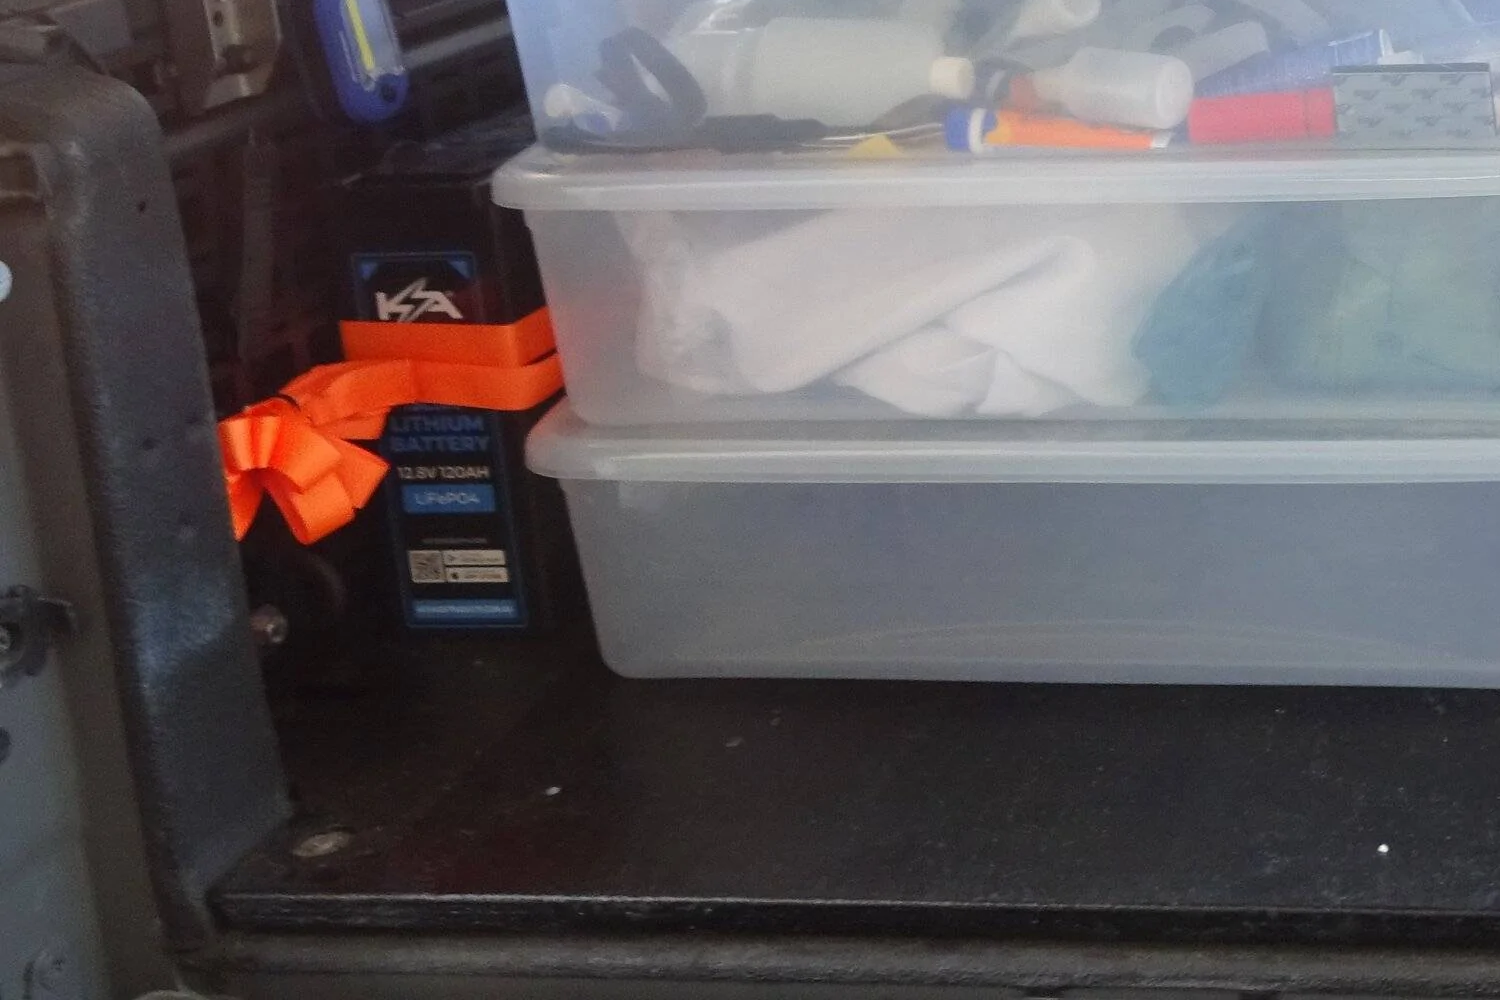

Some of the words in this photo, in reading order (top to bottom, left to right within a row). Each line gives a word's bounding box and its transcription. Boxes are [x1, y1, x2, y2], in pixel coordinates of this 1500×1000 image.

[388, 414, 485, 433] LITHIUM
[388, 435, 491, 452] BATTERY
[437, 465, 491, 480] 120AH
